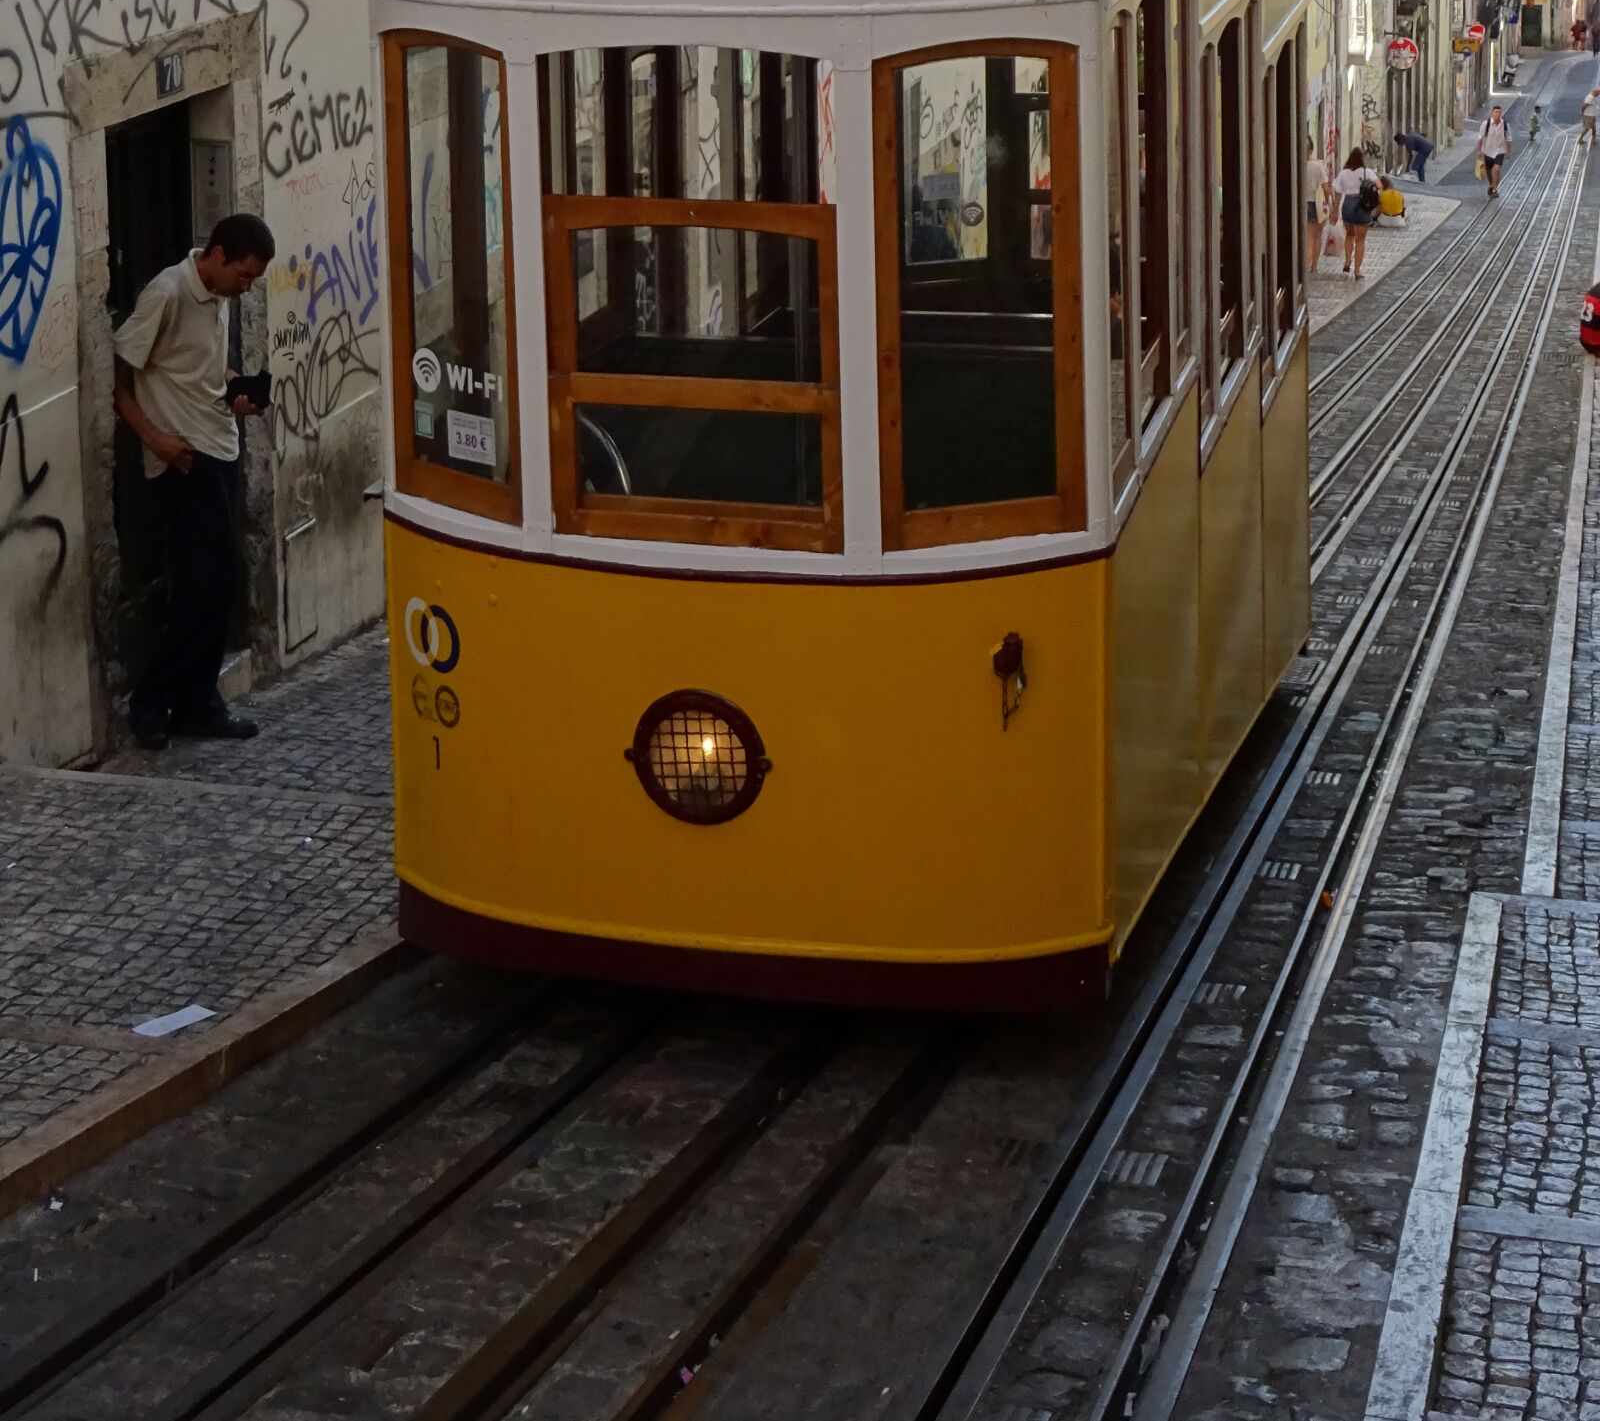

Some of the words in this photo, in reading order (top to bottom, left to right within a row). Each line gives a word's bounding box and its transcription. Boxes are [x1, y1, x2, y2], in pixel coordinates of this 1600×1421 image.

[163, 55, 181, 91] 70
[446, 362, 504, 402] WI-FI
[455, 431, 478, 449] 3.80
[480, 437, 487, 451] €
[432, 735, 441, 771] 1
